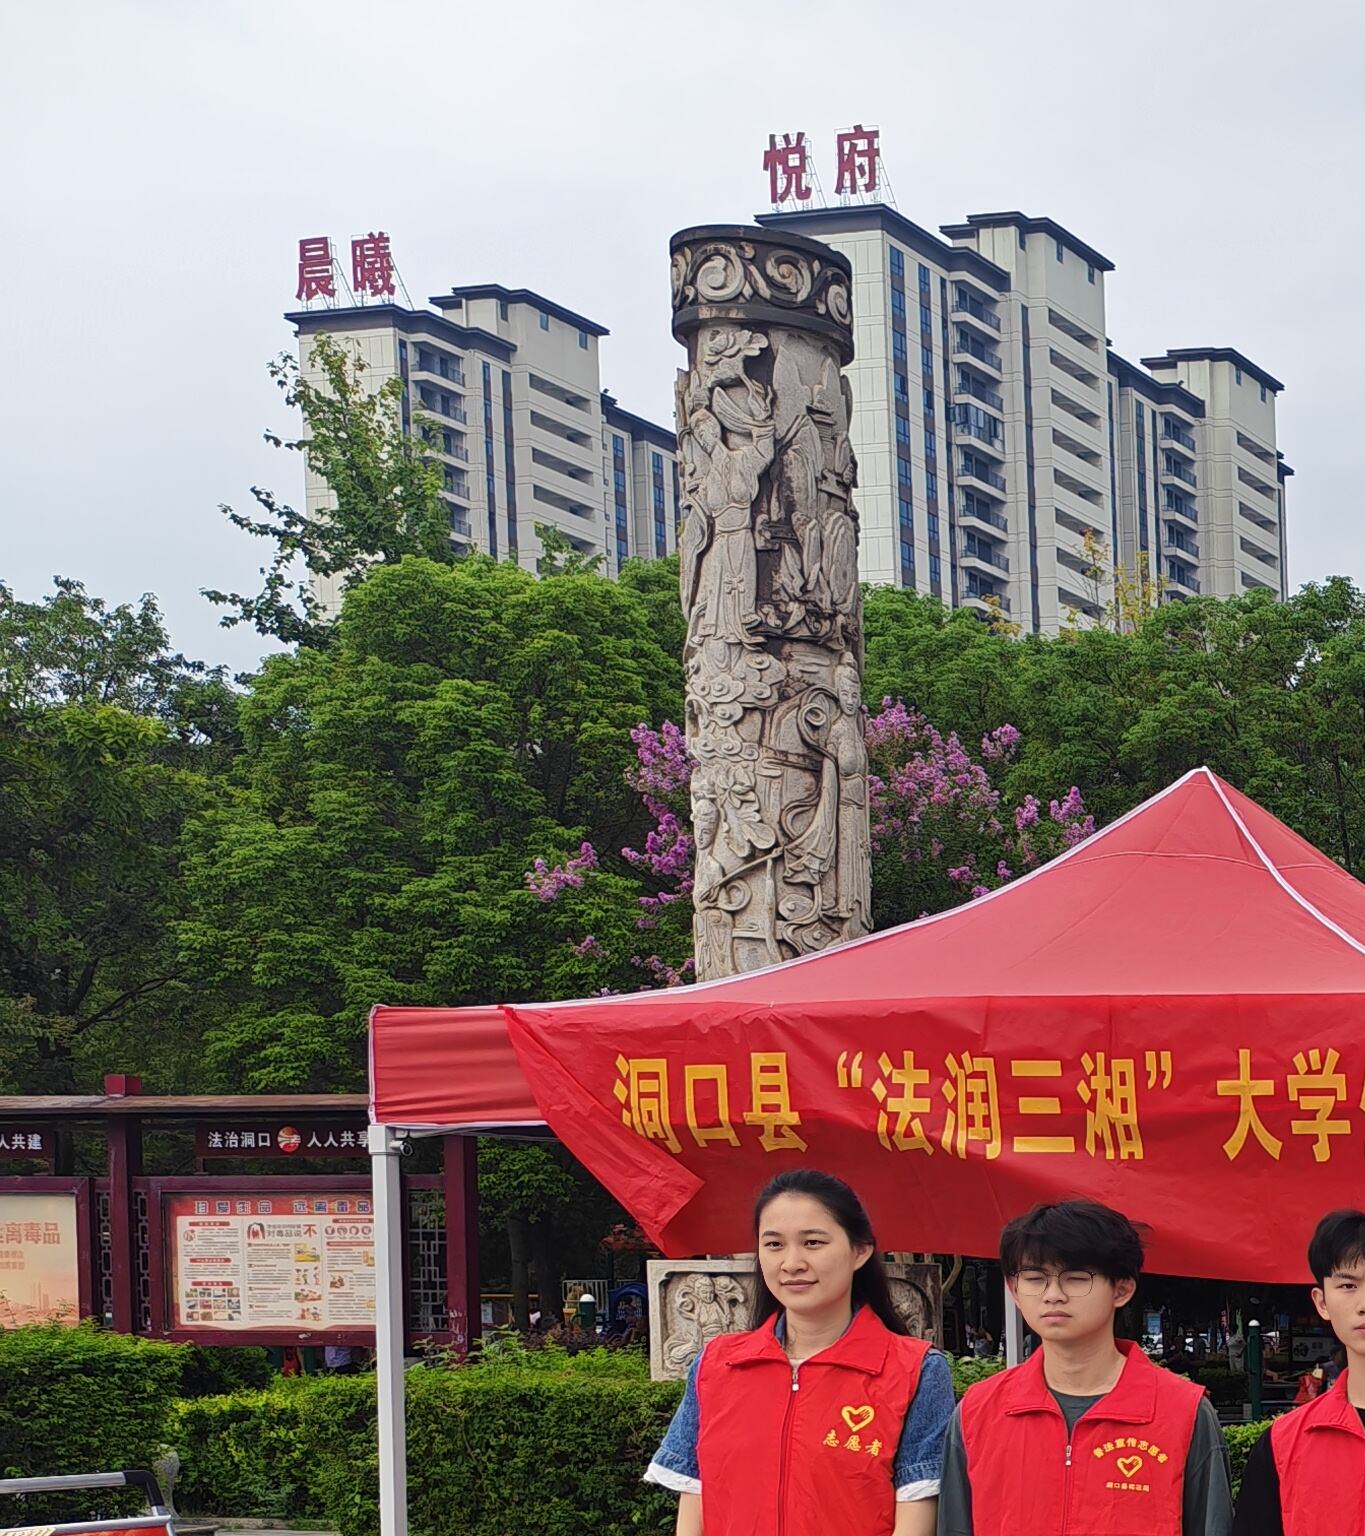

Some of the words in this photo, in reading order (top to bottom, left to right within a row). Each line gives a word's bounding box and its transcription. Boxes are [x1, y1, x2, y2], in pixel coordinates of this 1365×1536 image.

[764, 124, 880, 203] 悦府
[296, 231, 395, 301] 晨曦
[208, 1132, 270, 1148] 法治洞口
[307, 1131, 369, 1148] 人人共享
[0, 1222, 60, 1245] 离毒品
[823, 1429, 882, 1456] 志愿者
